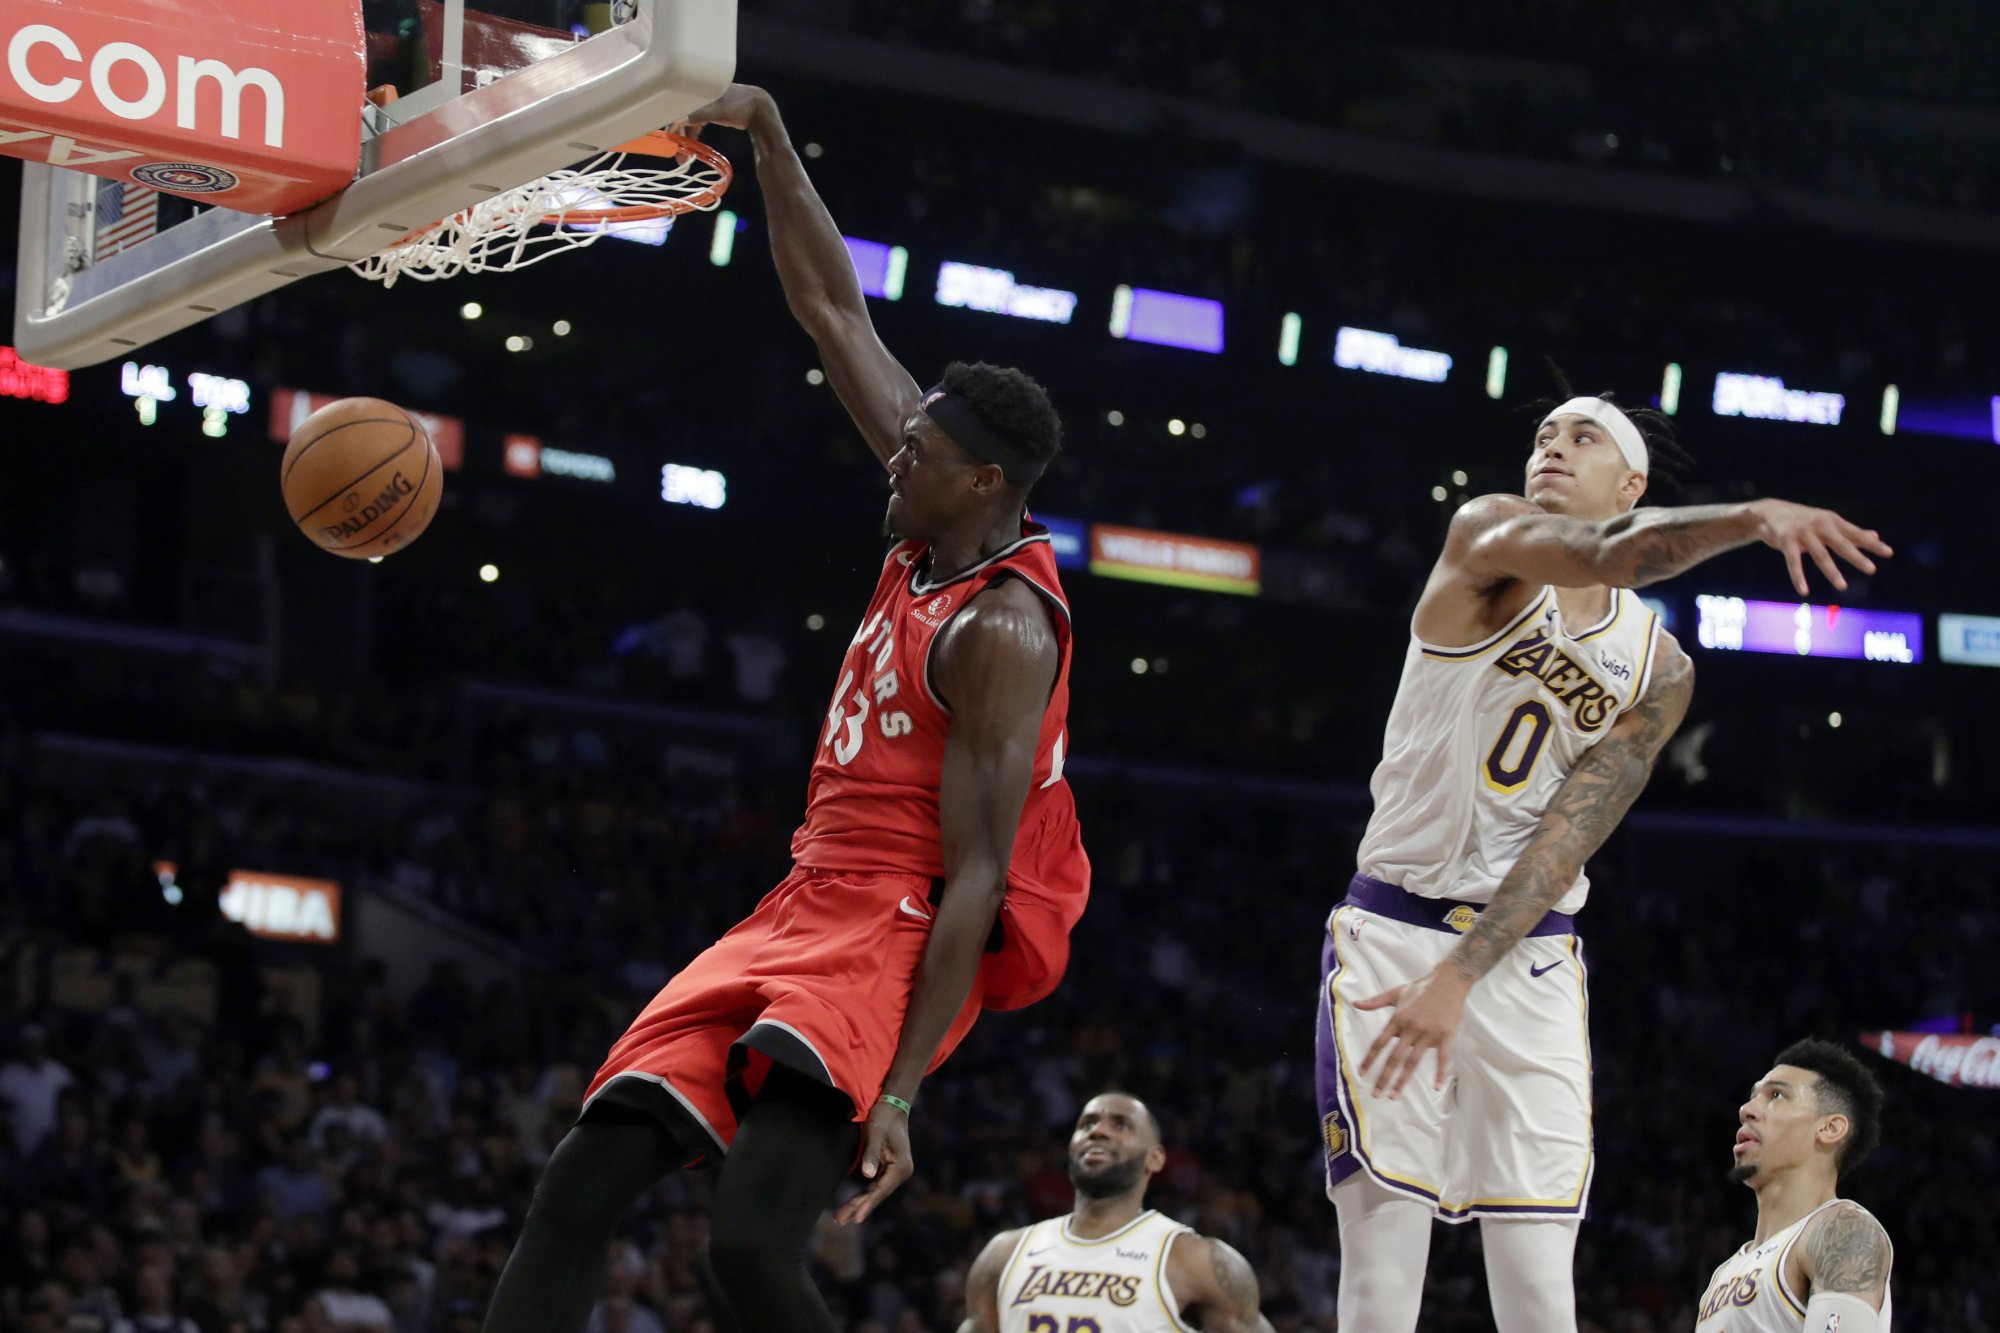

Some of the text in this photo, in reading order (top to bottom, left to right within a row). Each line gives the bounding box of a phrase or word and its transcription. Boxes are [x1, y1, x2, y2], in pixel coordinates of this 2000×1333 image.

[8, 24, 284, 148] com
[911, 609, 927, 622] Sun
[1493, 628, 1619, 733] LAERS
[1601, 650, 1631, 681] wish
[825, 670, 870, 766] 43
[1483, 699, 1551, 795] 0
[1009, 1264, 1142, 1308] LAKERS
[1115, 1247, 1149, 1262] wish
